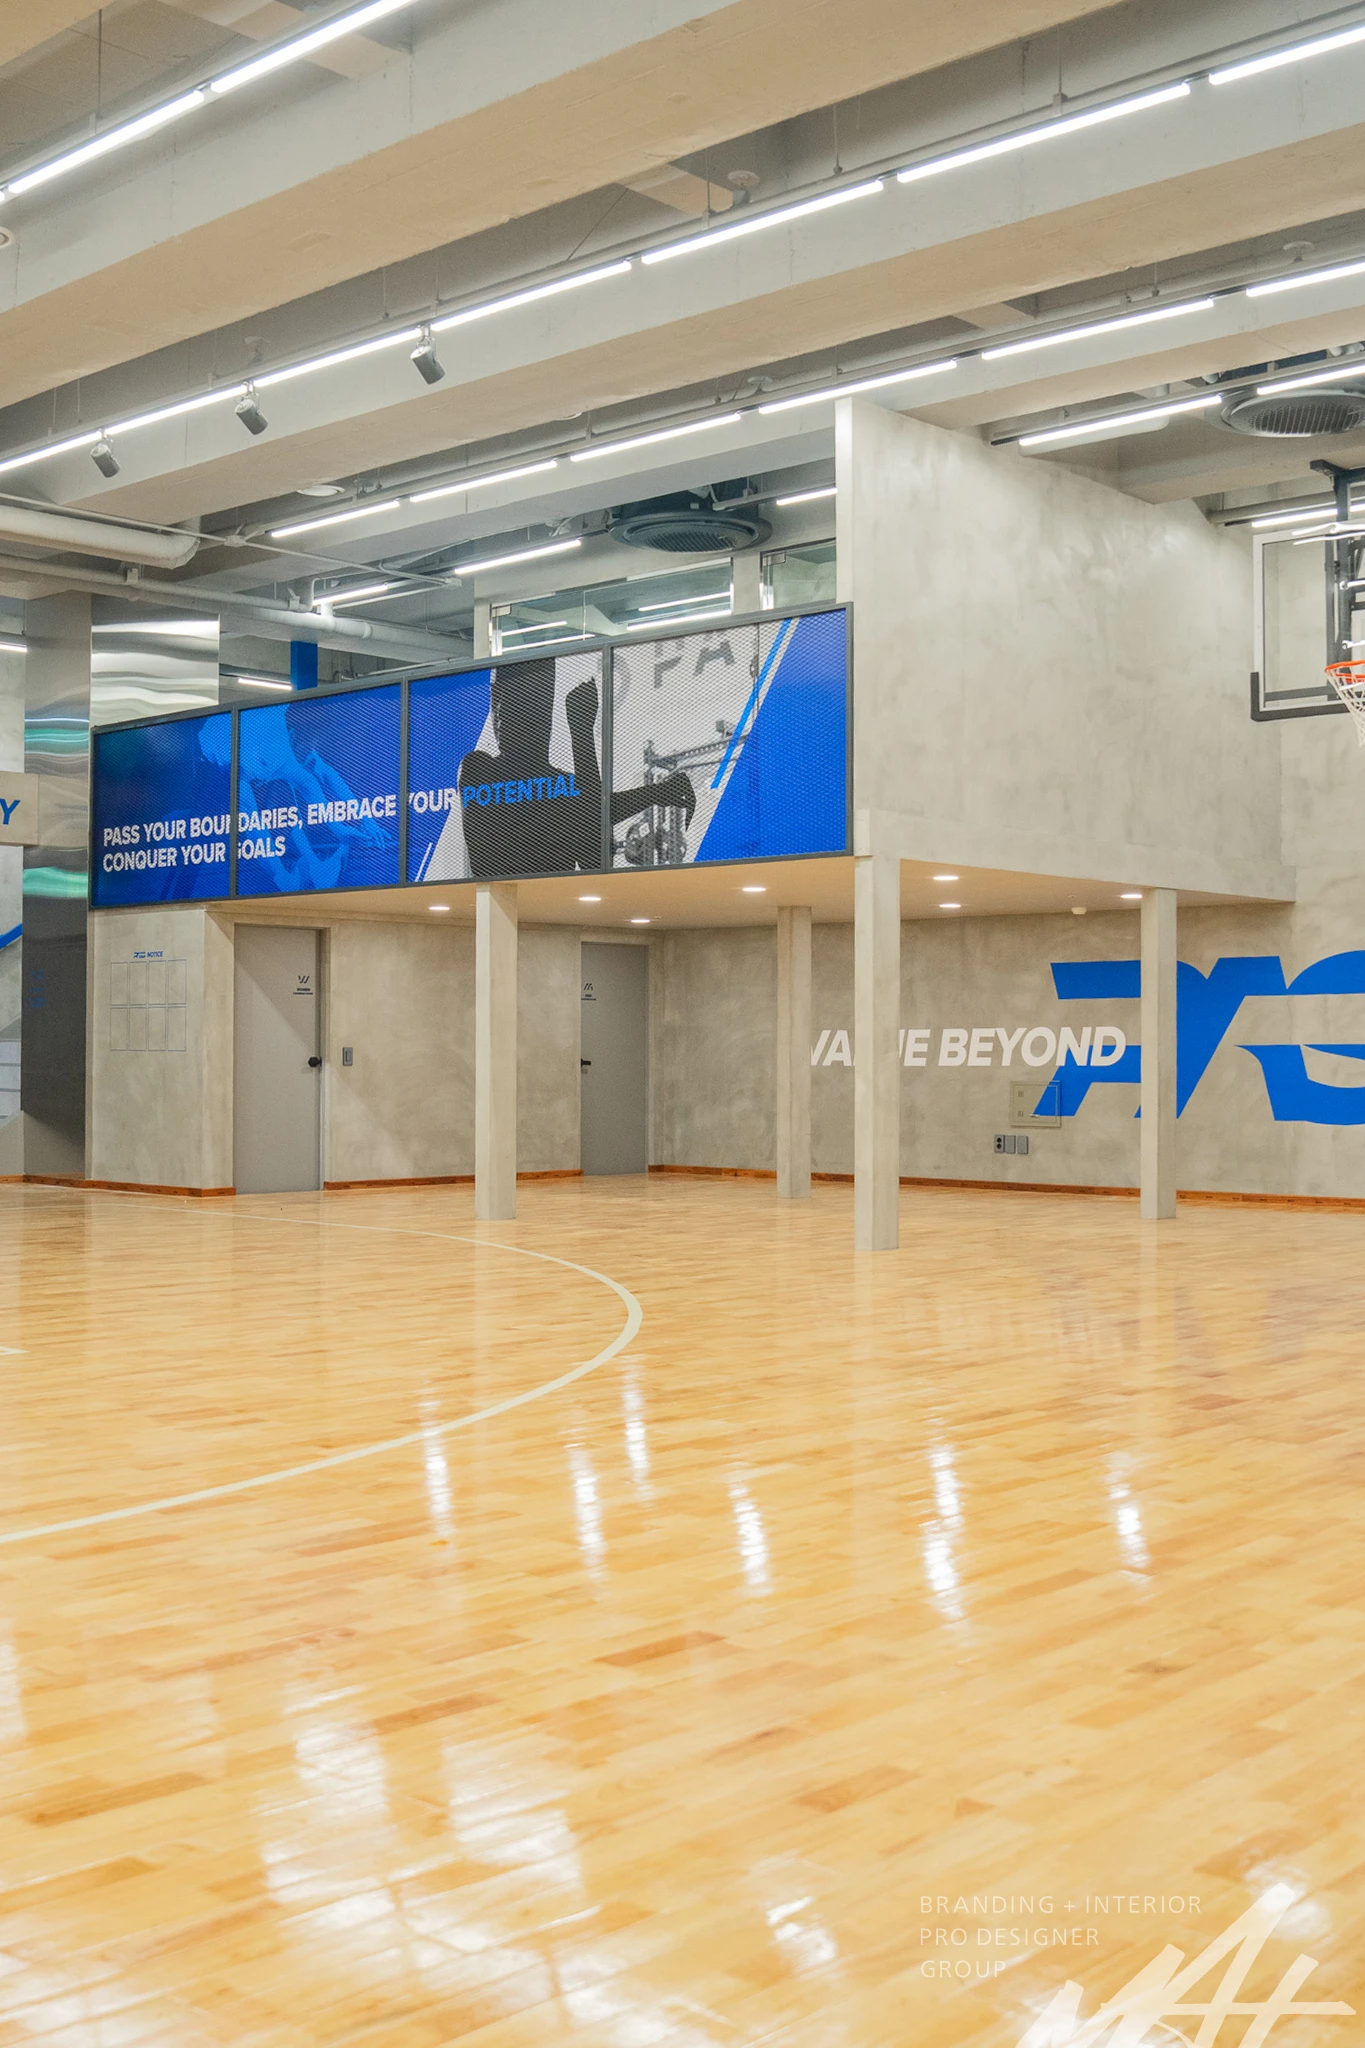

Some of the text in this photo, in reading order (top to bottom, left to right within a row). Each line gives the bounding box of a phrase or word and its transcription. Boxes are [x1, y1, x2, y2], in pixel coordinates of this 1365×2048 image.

[103, 825, 140, 847] PASS
[143, 819, 187, 843] YOUR
[307, 794, 397, 826] EMBRACE
[463, 774, 581, 808] POTENTIAL
[102, 847, 178, 873] CONQUER
[181, 842, 226, 865] YOUR
[147, 950, 163, 958] NOTICE
[810, 1025, 1126, 1067] VAE BEYOND
